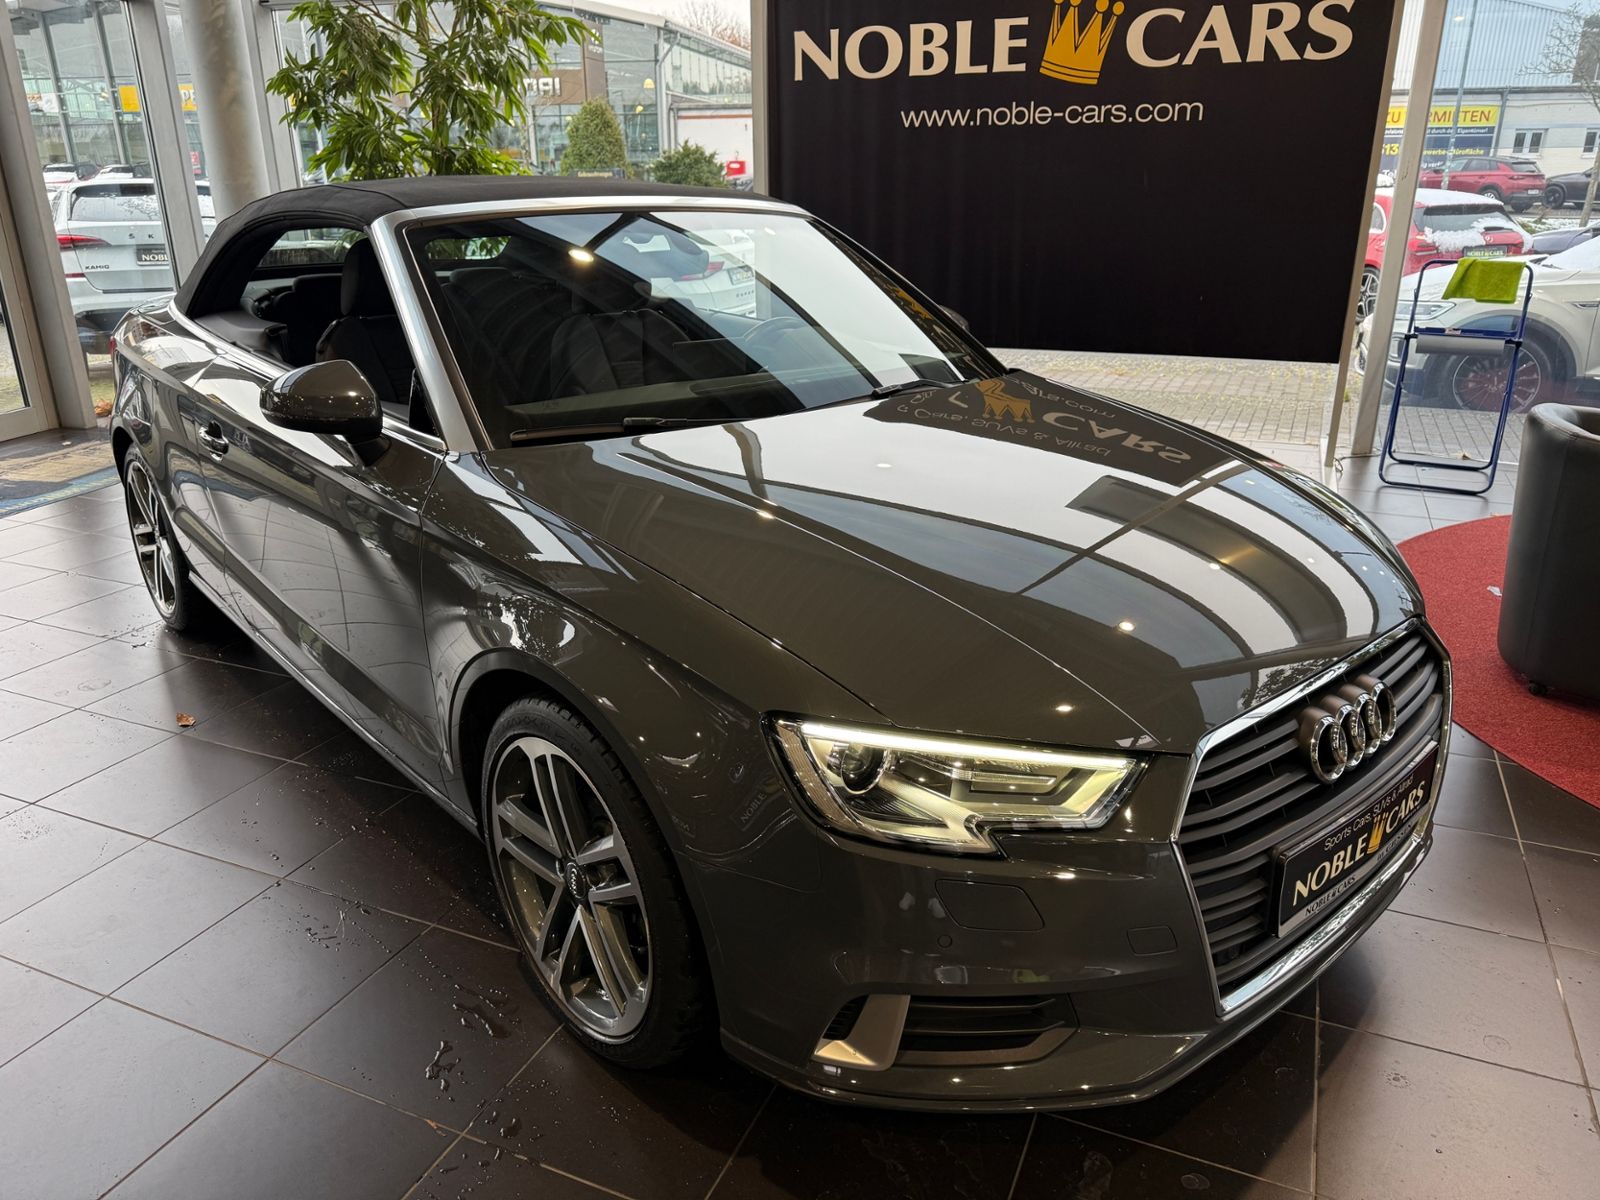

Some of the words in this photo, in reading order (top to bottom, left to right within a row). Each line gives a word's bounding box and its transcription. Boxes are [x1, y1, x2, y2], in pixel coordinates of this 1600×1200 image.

[794, 17, 1029, 81] NOBLE
[1126, 0, 1355, 68] CARS
[900, 101, 1204, 128] www.noble-cars.com
[1293, 832, 1368, 906] NOBLE
[1385, 780, 1426, 833] CARS
[1324, 826, 1352, 851] Sports
[1305, 894, 1332, 916] NOBLE
